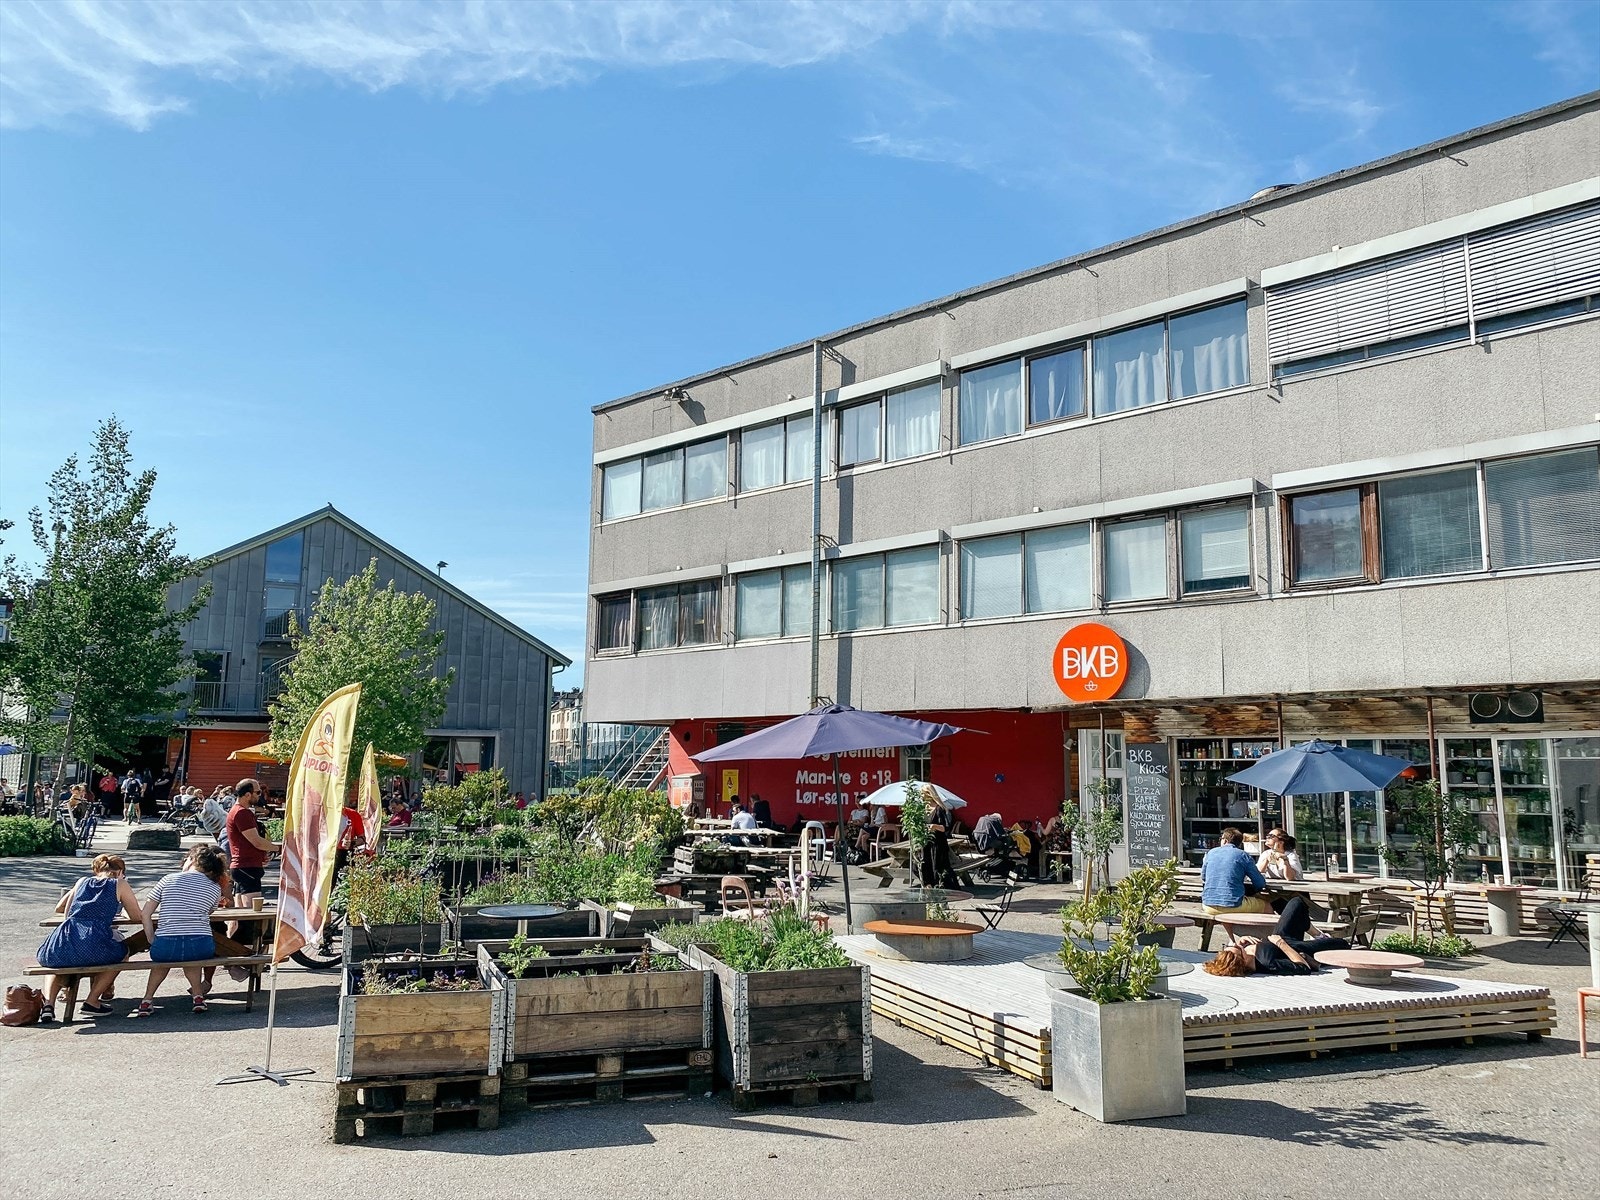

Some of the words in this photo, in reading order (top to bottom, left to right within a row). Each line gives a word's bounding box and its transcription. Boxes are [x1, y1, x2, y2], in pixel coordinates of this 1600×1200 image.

[1063, 645, 1118, 679] BKB
[1129, 749, 1153, 762] BKB
[1139, 762, 1168, 774] KIOSK
[1133, 786, 1161, 796] PIZZA
[1135, 794, 1159, 804] KAFFE
[1132, 802, 1162, 812] BAKVERK
[1135, 829, 1161, 838] UTSTYR
